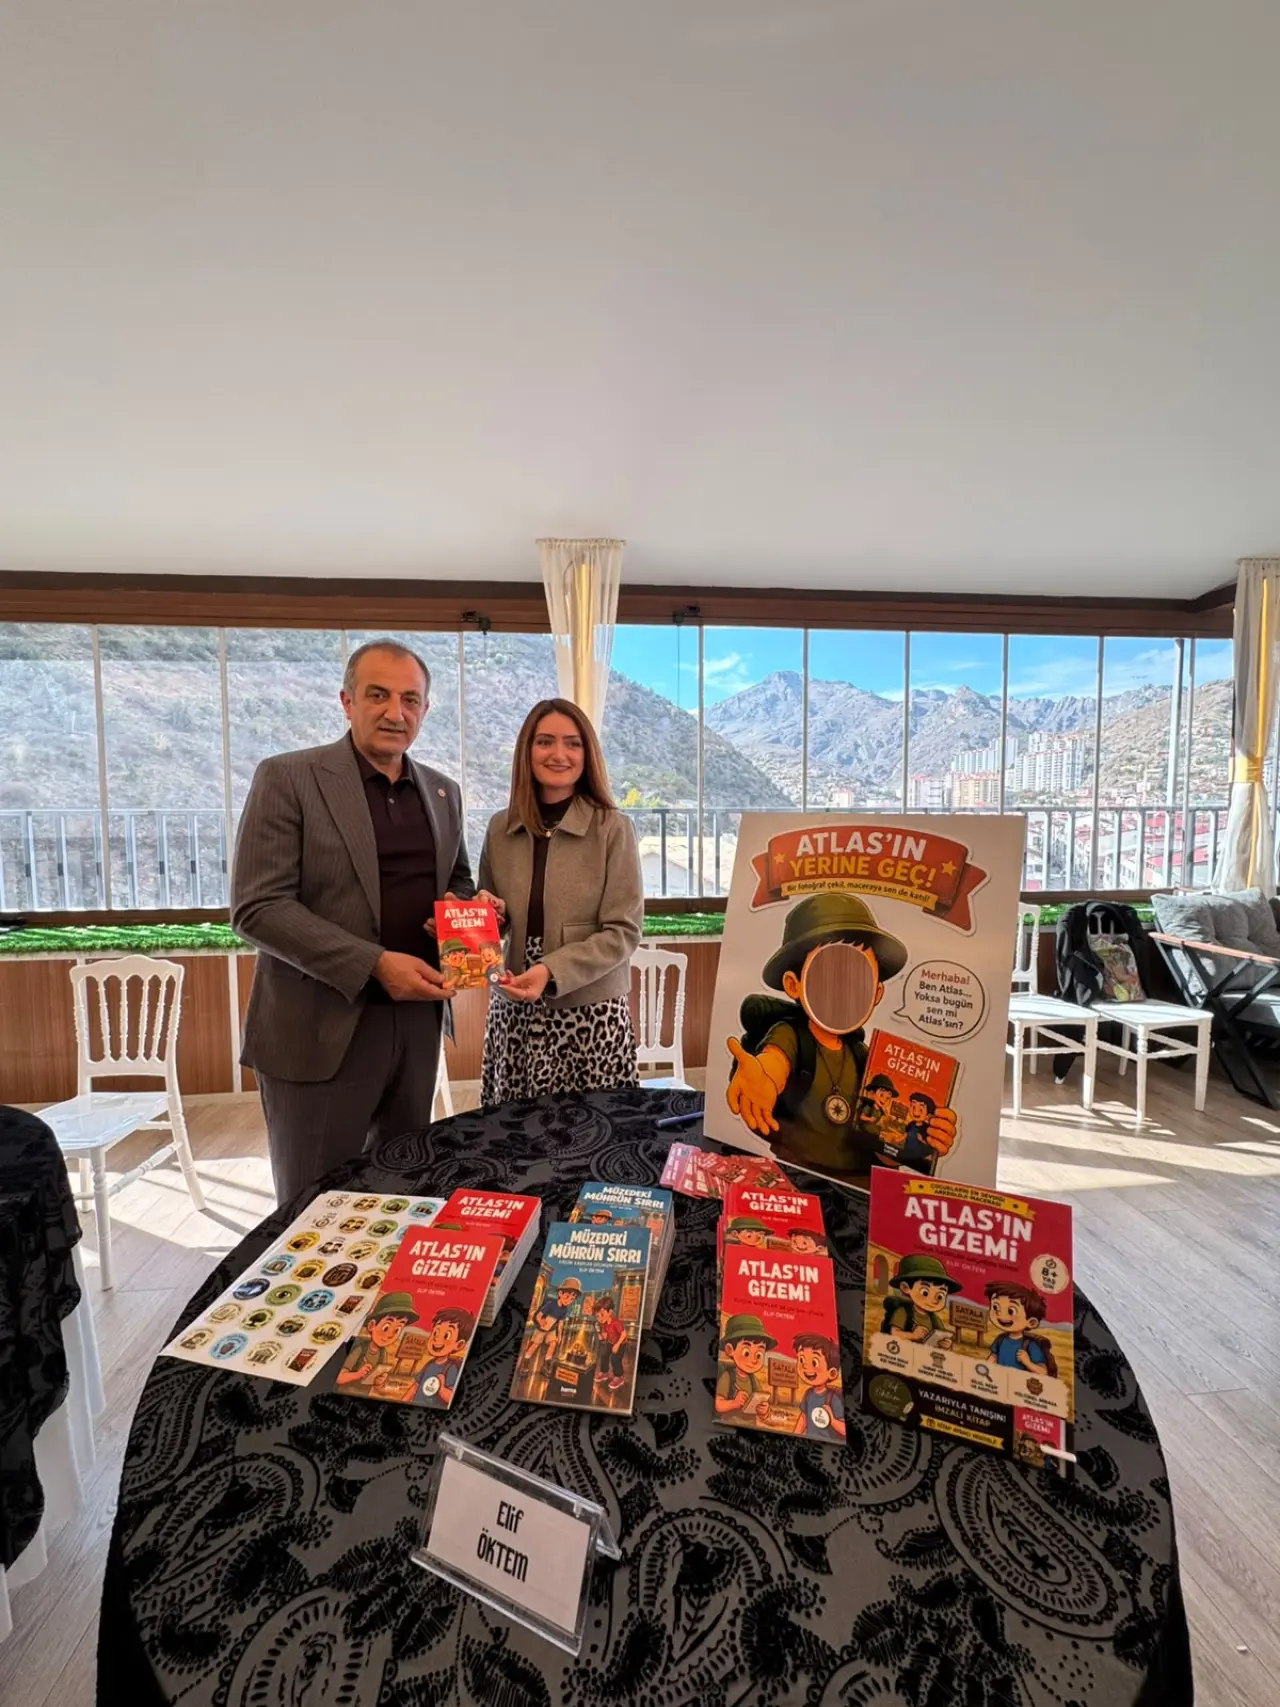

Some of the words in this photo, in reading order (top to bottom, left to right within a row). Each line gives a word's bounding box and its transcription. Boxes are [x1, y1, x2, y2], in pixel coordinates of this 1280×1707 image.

[796, 831, 927, 861] ATLAS'IN
[789, 853, 871, 877] YERİNE
[877, 858, 936, 888] GEÇ!
[847, 882, 882, 892] maceraya
[883, 886, 897, 894] sen
[899, 888, 908, 896] de
[444, 908, 488, 919] ATLAS'IN
[919, 981, 937, 991] Ben
[921, 969, 971, 985] Merhaba!
[915, 991, 941, 1003] Yoksa
[943, 996, 973, 1009] bugün
[926, 1006, 943, 1015] sen
[945, 1008, 957, 1018] mi
[884, 1043, 941, 1073] ATLAS'IN
[458, 1196, 525, 1211] ATLAS'IN
[634, 1197, 664, 1209] SIRRI
[741, 1191, 809, 1207] ATLAS'IN
[904, 1196, 1033, 1242] ATLAS'IN
[570, 1229, 628, 1246] MÜZEDEKİ
[409, 1240, 486, 1262] ATLAS'IN
[548, 1243, 604, 1261] MÜHRÜN
[607, 1248, 642, 1264] SIRRI
[738, 1259, 819, 1284] ATLAS'IN
[496, 1500, 525, 1534] Elif
[477, 1527, 529, 1583] ÖKTEM
